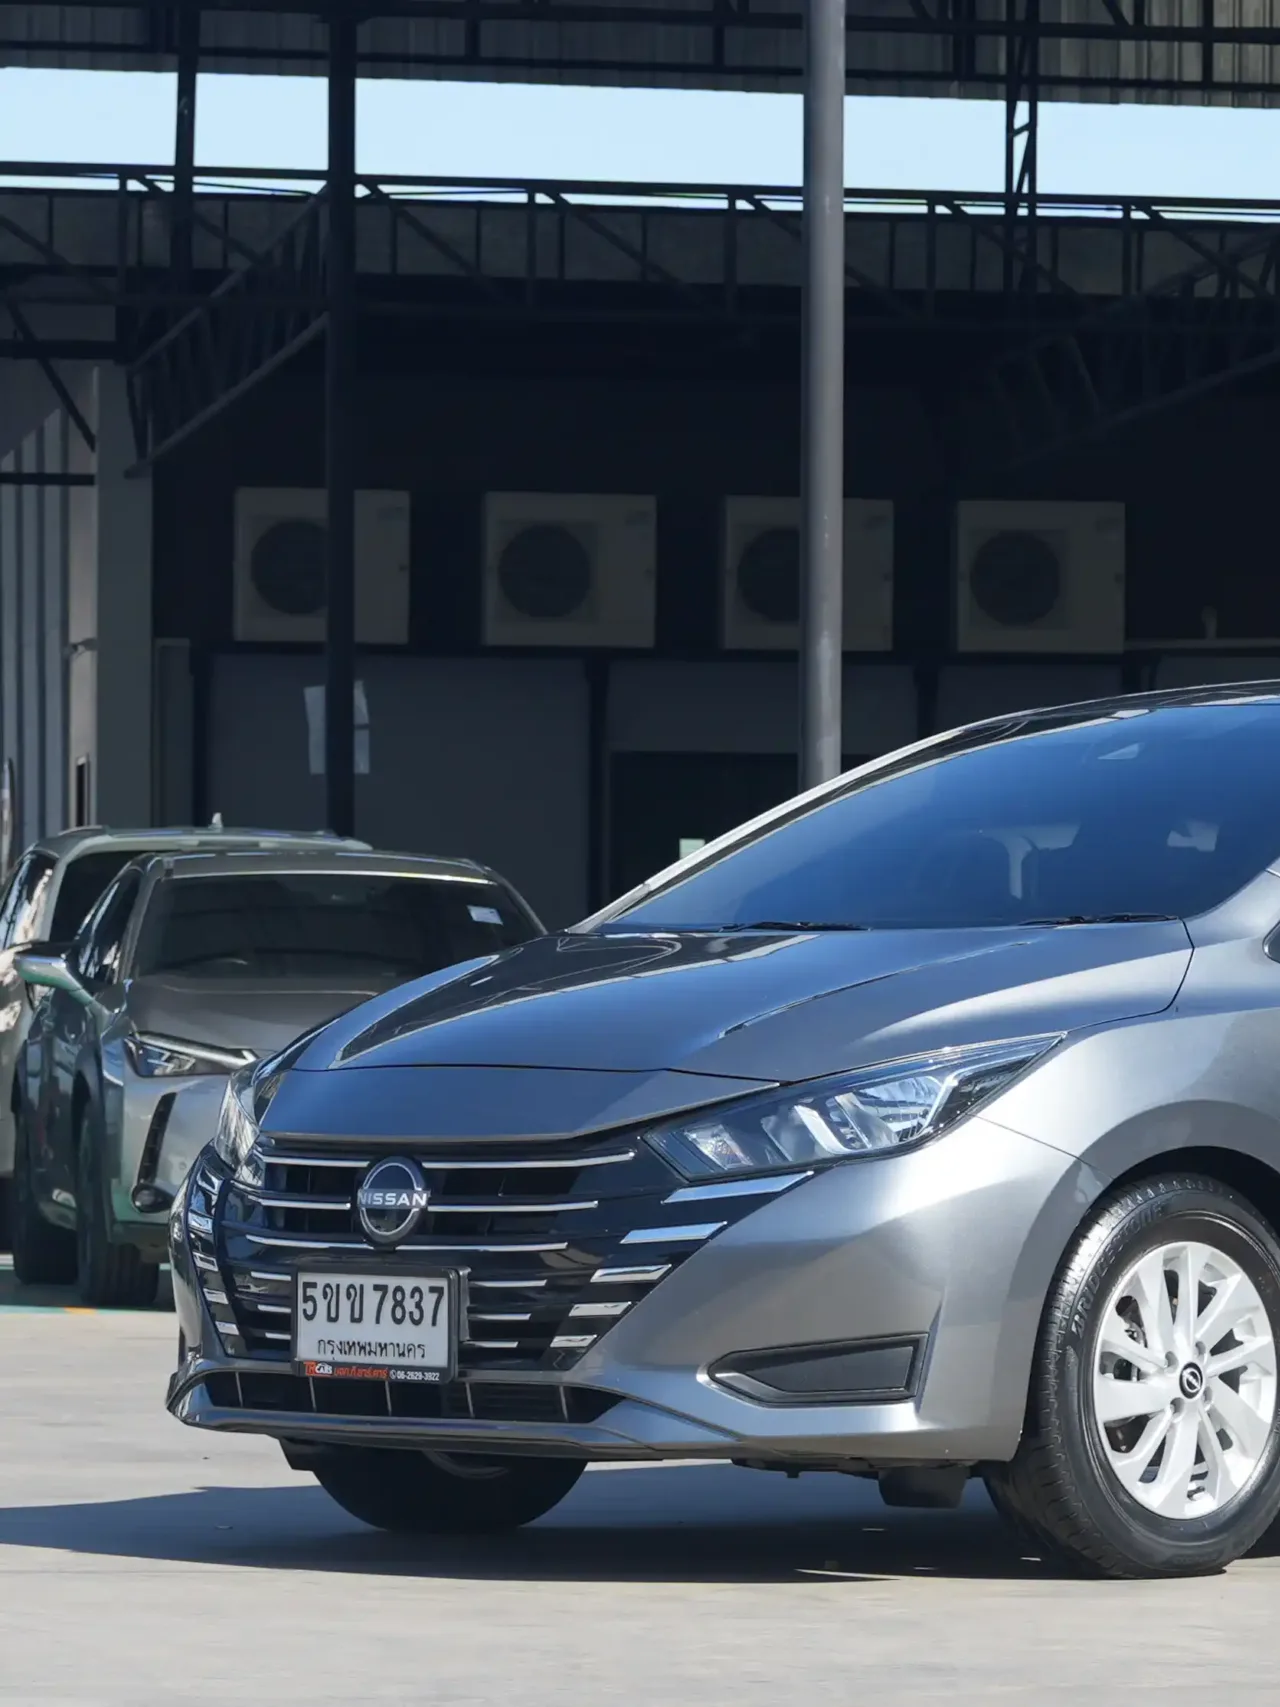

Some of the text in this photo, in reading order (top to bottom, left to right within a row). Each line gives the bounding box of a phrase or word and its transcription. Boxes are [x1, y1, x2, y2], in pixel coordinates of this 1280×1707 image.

[359, 1192, 427, 1206] NISSAN
[302, 1281, 445, 1327] 5ขข 7837
[317, 1338, 426, 1361] กรุงเทพมหานคร
